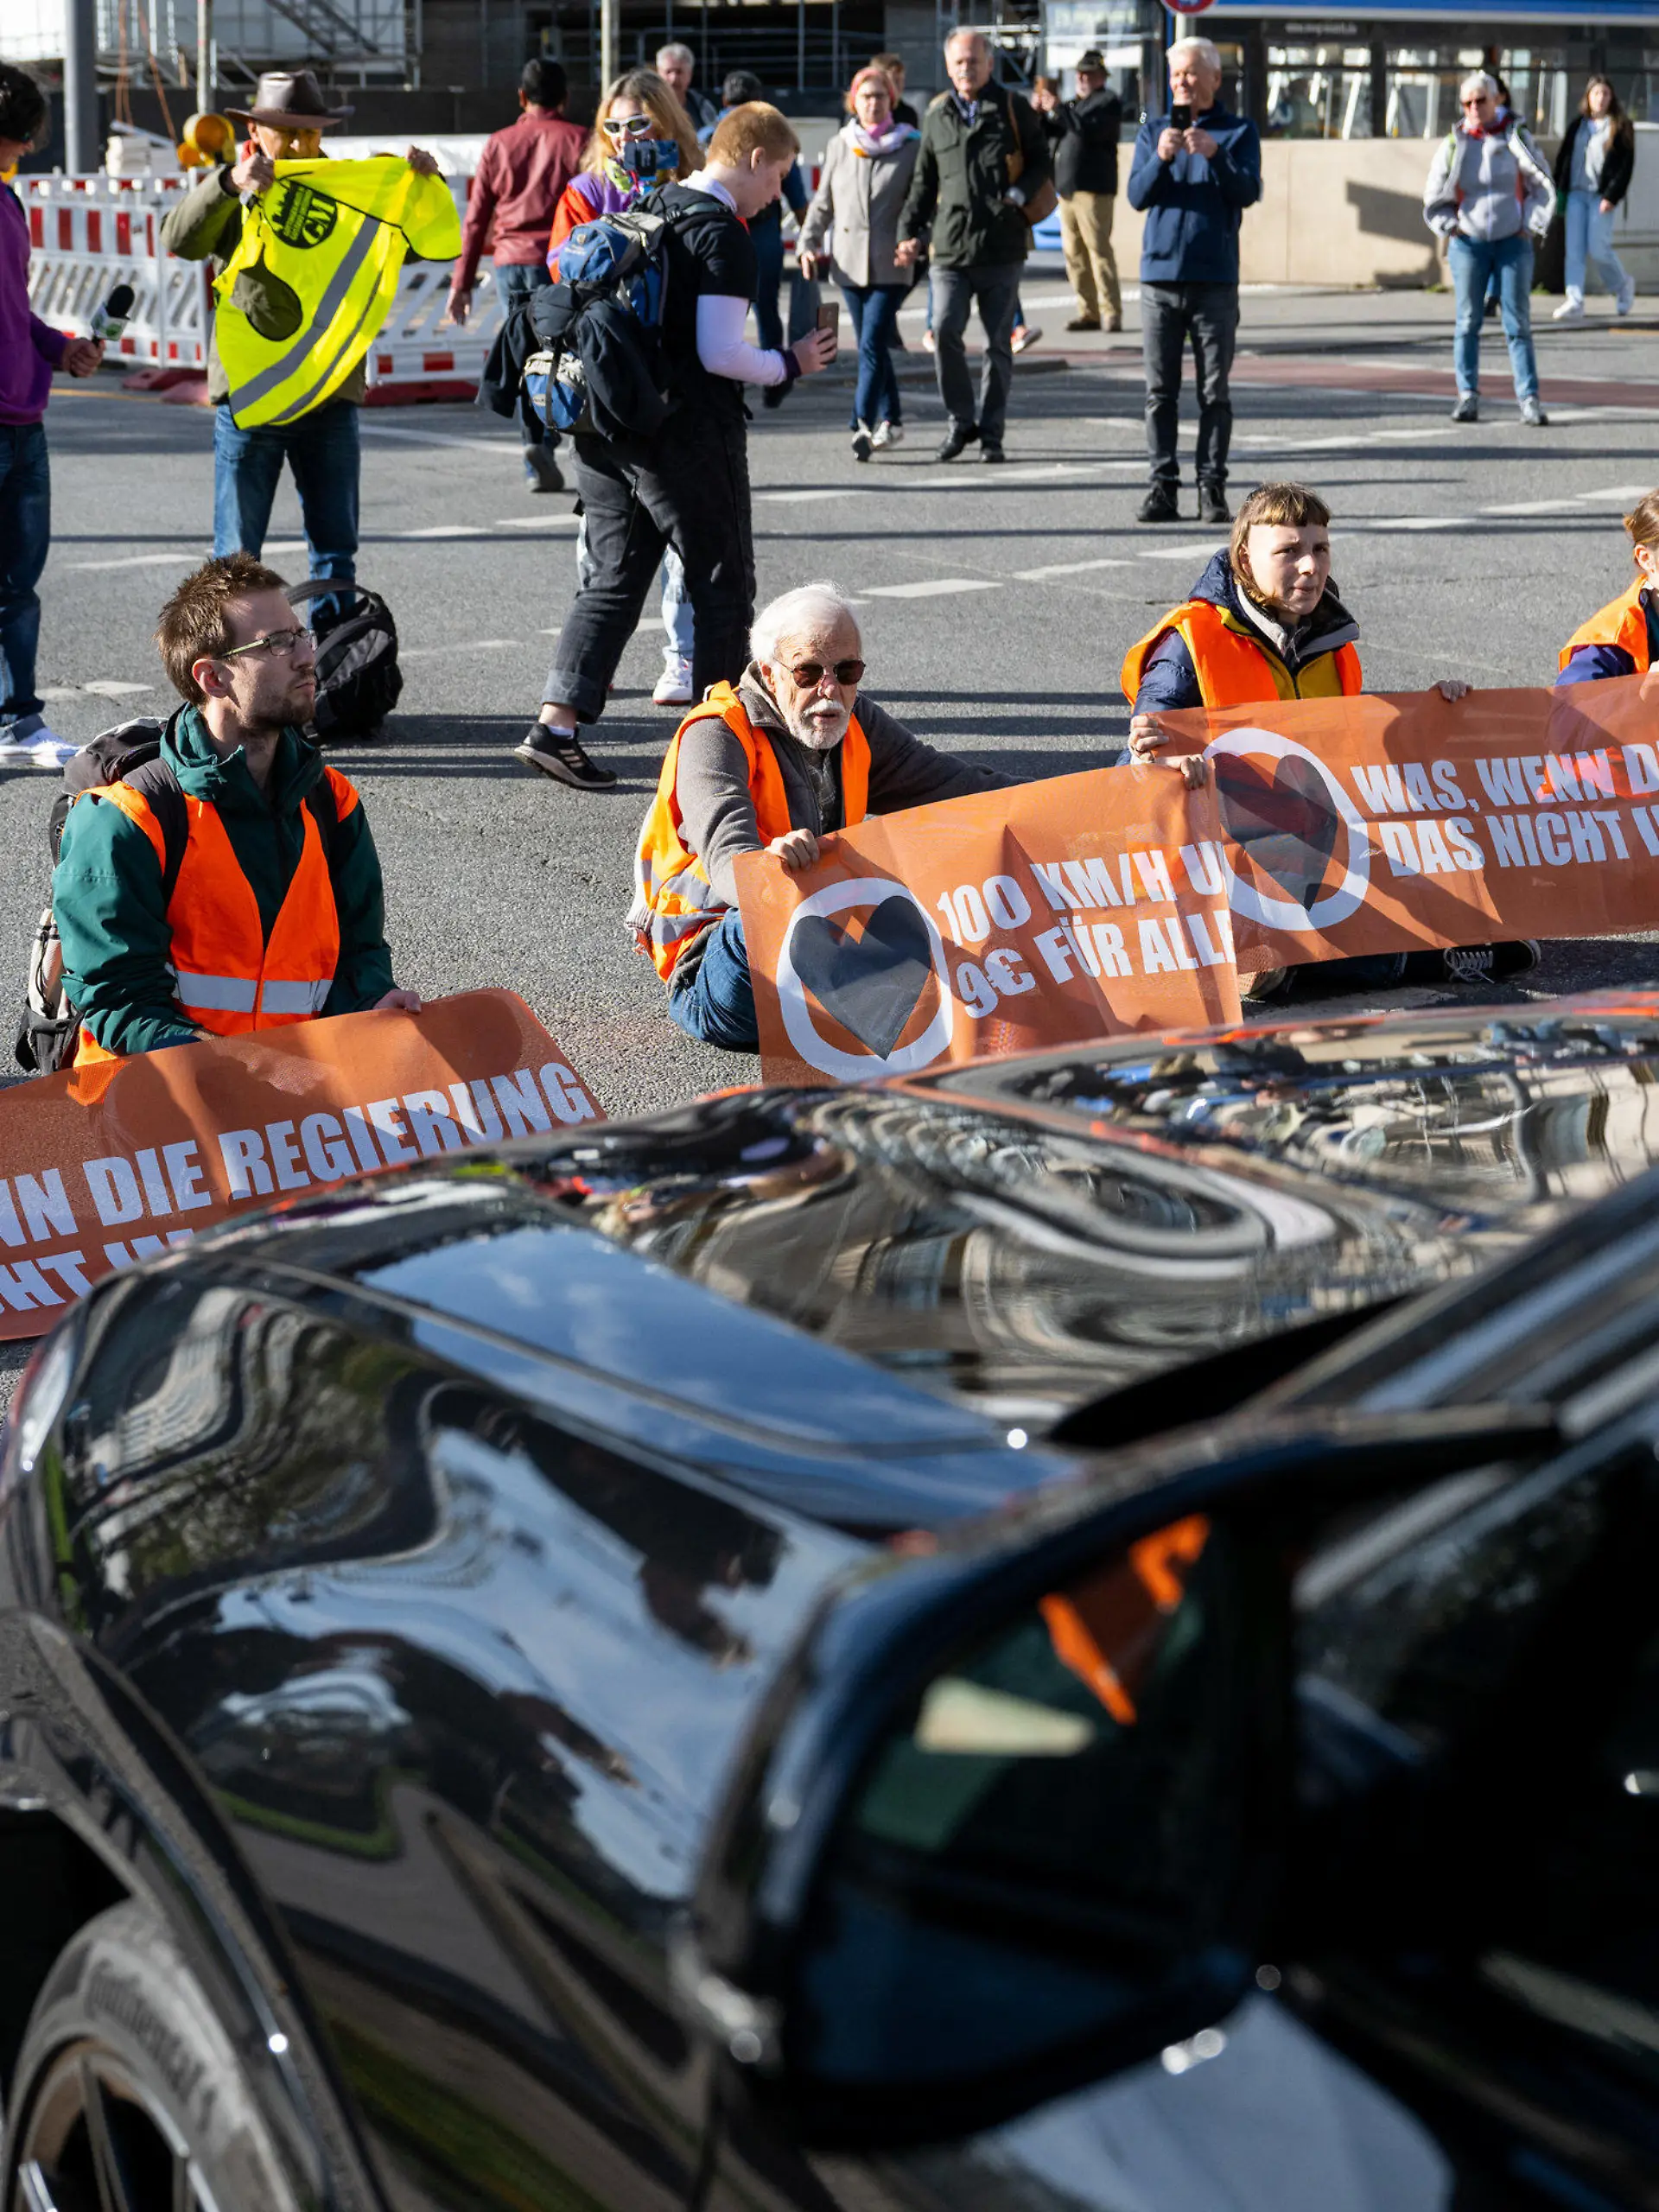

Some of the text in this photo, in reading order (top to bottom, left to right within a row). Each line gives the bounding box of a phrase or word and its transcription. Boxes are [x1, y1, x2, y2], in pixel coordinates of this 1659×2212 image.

[1350, 742, 1659, 813] WAS, WENN D
[1378, 817, 1486, 877] DAS
[1484, 810, 1630, 868] NICHT
[936, 841, 1225, 948] 100 KM/H U
[956, 949, 1036, 1019] 9€
[1033, 914, 1132, 984] FÜR
[82, 1140, 213, 1227] DIE
[218, 1062, 596, 1200] REGIERUNG
[0, 1250, 95, 1312] HT
